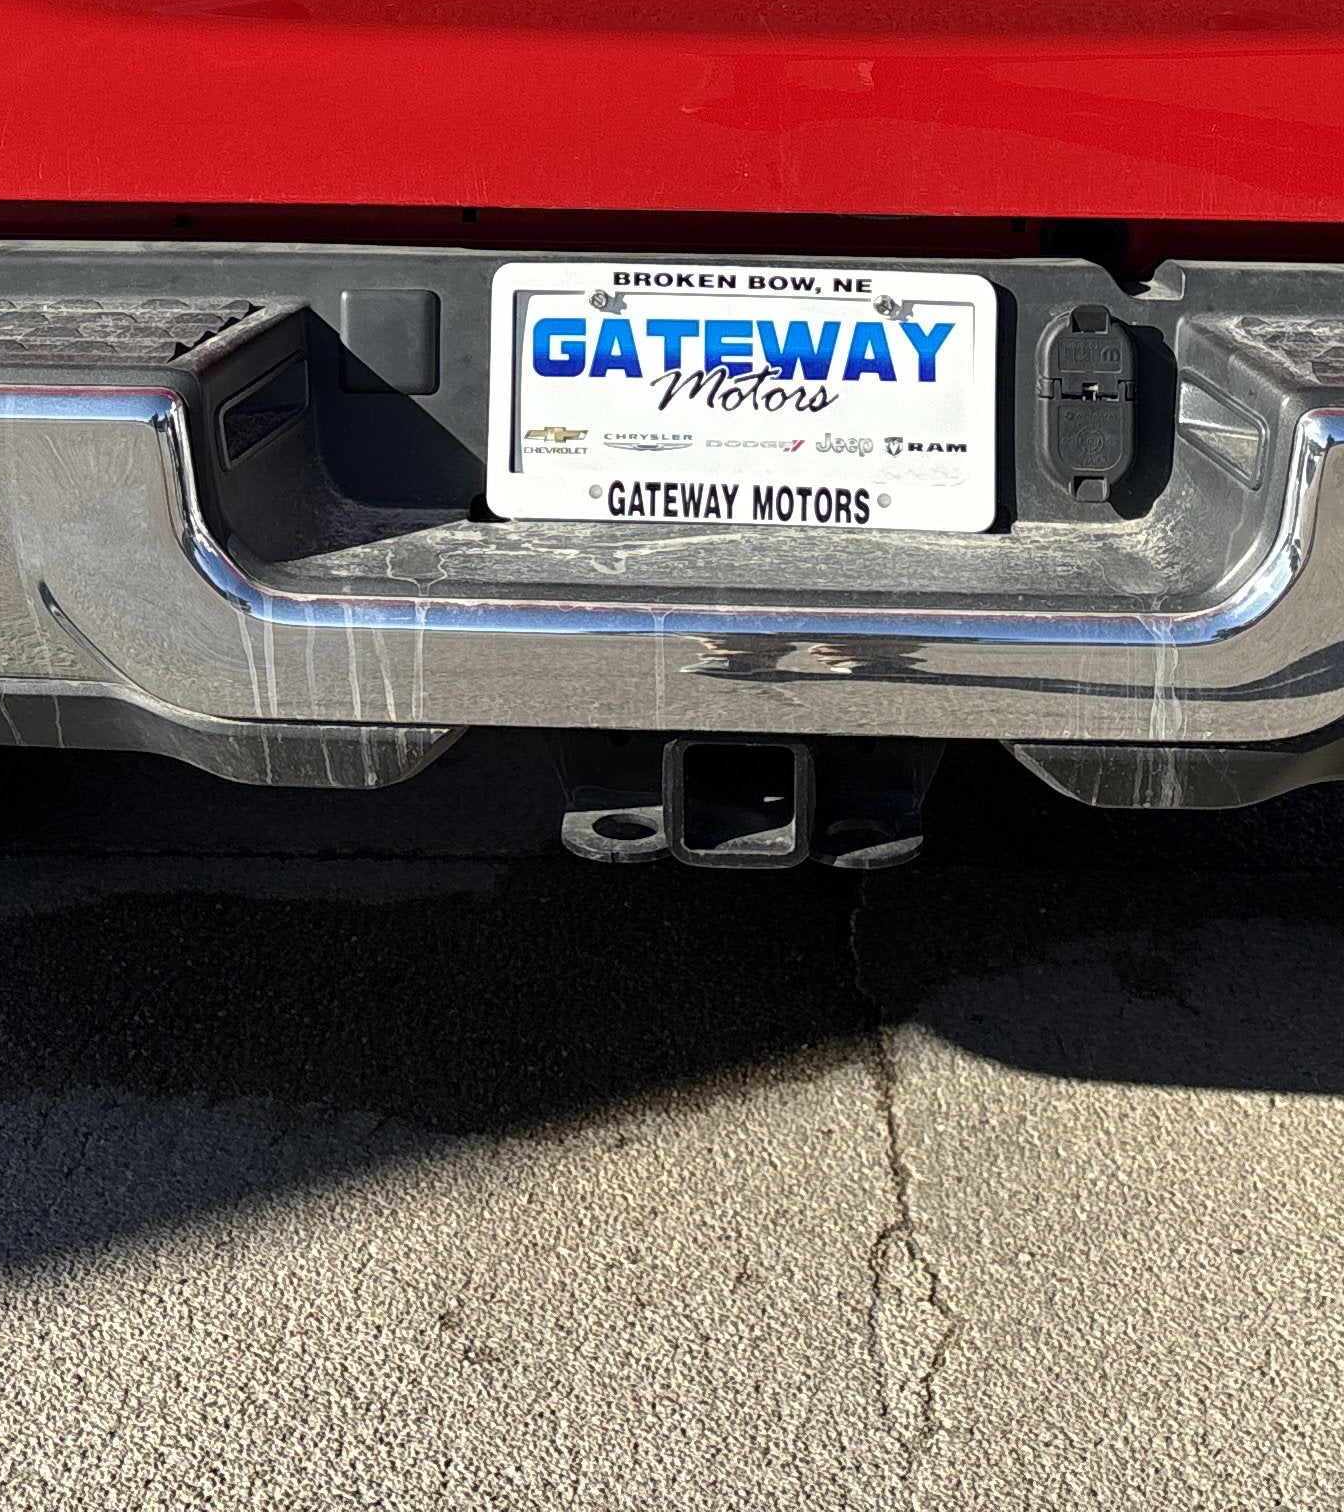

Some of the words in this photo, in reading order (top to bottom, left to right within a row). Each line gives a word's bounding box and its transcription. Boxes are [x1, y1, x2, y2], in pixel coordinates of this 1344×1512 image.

[612, 271, 737, 290] BROKEN
[748, 276, 822, 295] BOW,
[833, 277, 873, 294] NE
[531, 317, 957, 383] GATEWAY
[649, 366, 840, 413] Motors
[523, 446, 589, 455] CHEVROLET
[603, 432, 693, 441] CHRYSLER
[705, 439, 793, 449] DODGE
[815, 432, 874, 458] Jeep
[907, 442, 968, 453] RAM
[607, 480, 739, 521] GATEWAY
[752, 484, 871, 524] MOTORS
